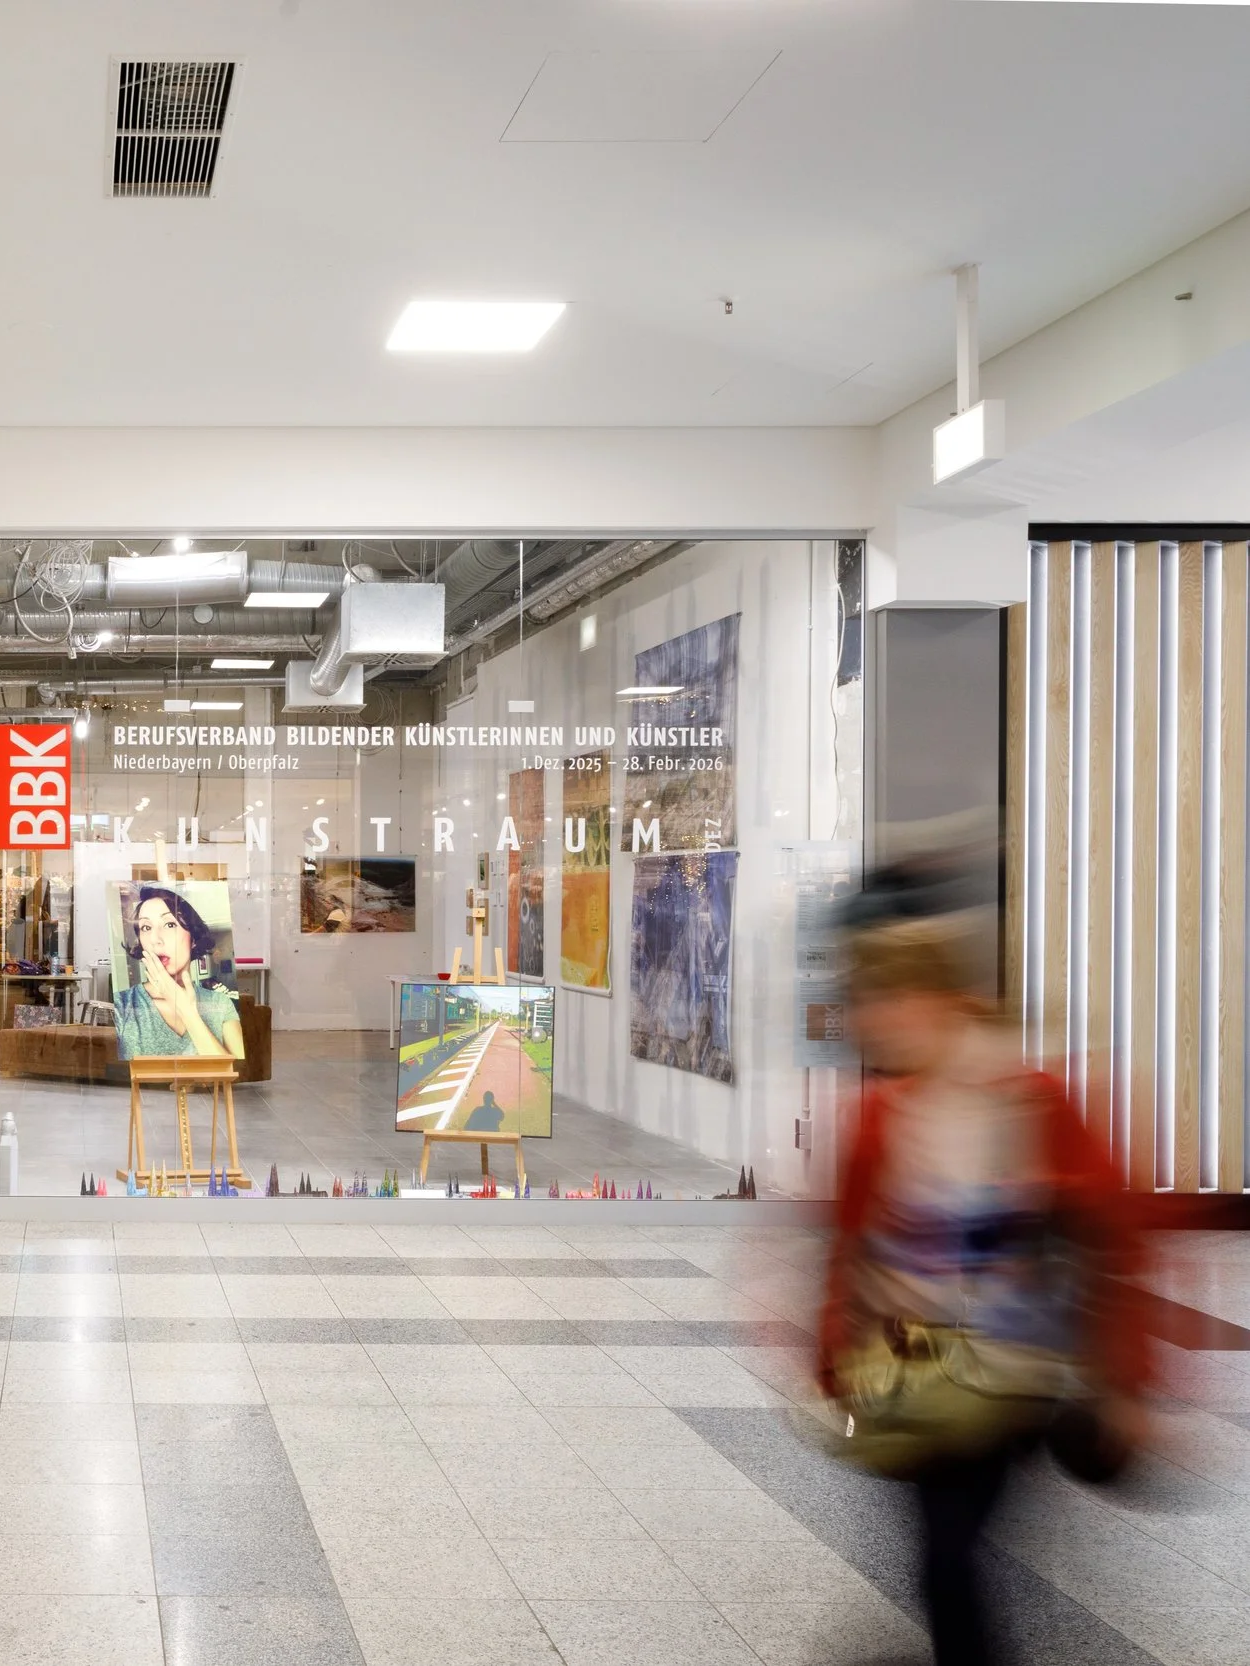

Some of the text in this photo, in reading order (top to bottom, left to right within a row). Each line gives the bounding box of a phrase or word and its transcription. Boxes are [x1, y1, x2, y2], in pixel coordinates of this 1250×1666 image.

[113, 722, 724, 747] BERUFSVERBAND BILDENDER KÜNSTLERINNEN UND KÜNSTLER
[113, 754, 211, 773] Niederbayern
[228, 754, 299, 771] Oberpfalz
[568, 757, 602, 773] 2025
[622, 756, 644, 771] 28.
[648, 755, 686, 771] Febr.
[689, 756, 724, 771] 2026
[9, 728, 67, 845] BBK
[112, 815, 662, 853] KUNSTRAUM
[704, 818, 722, 853] DEZ
[825, 1005, 843, 1040] BBK
